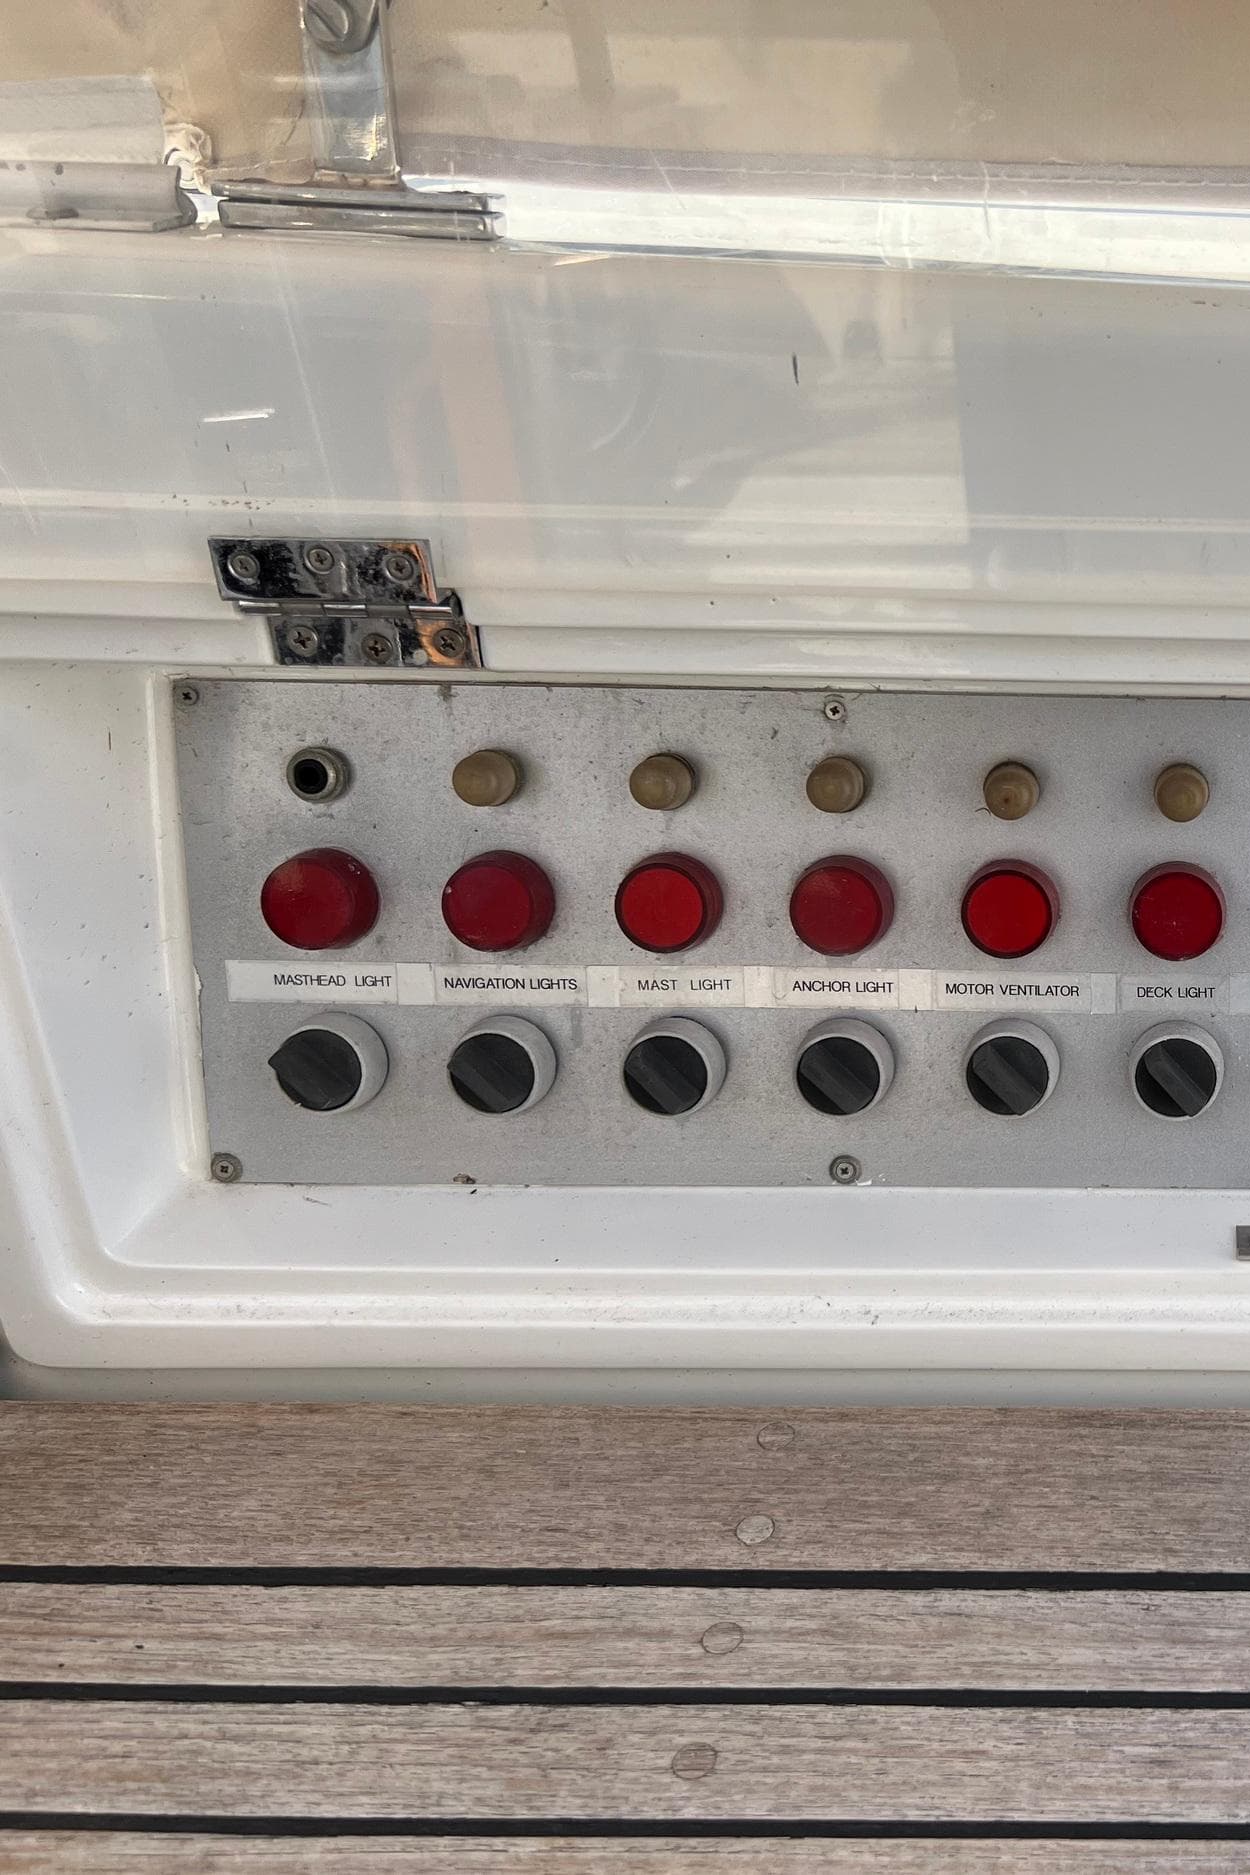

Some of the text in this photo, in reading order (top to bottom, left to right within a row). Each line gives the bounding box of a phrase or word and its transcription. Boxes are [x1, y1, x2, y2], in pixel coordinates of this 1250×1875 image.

[273, 974, 392, 988] MASTHEAD LIGHT
[444, 977, 578, 991] NAVIGATION LIGHTS
[637, 979, 732, 991] MAST LIGHT
[792, 980, 894, 994] ANCHOR LIGHT
[945, 983, 1081, 997] MOTOR VENTILATOR
[1137, 986, 1216, 999] DECK LIGHT
